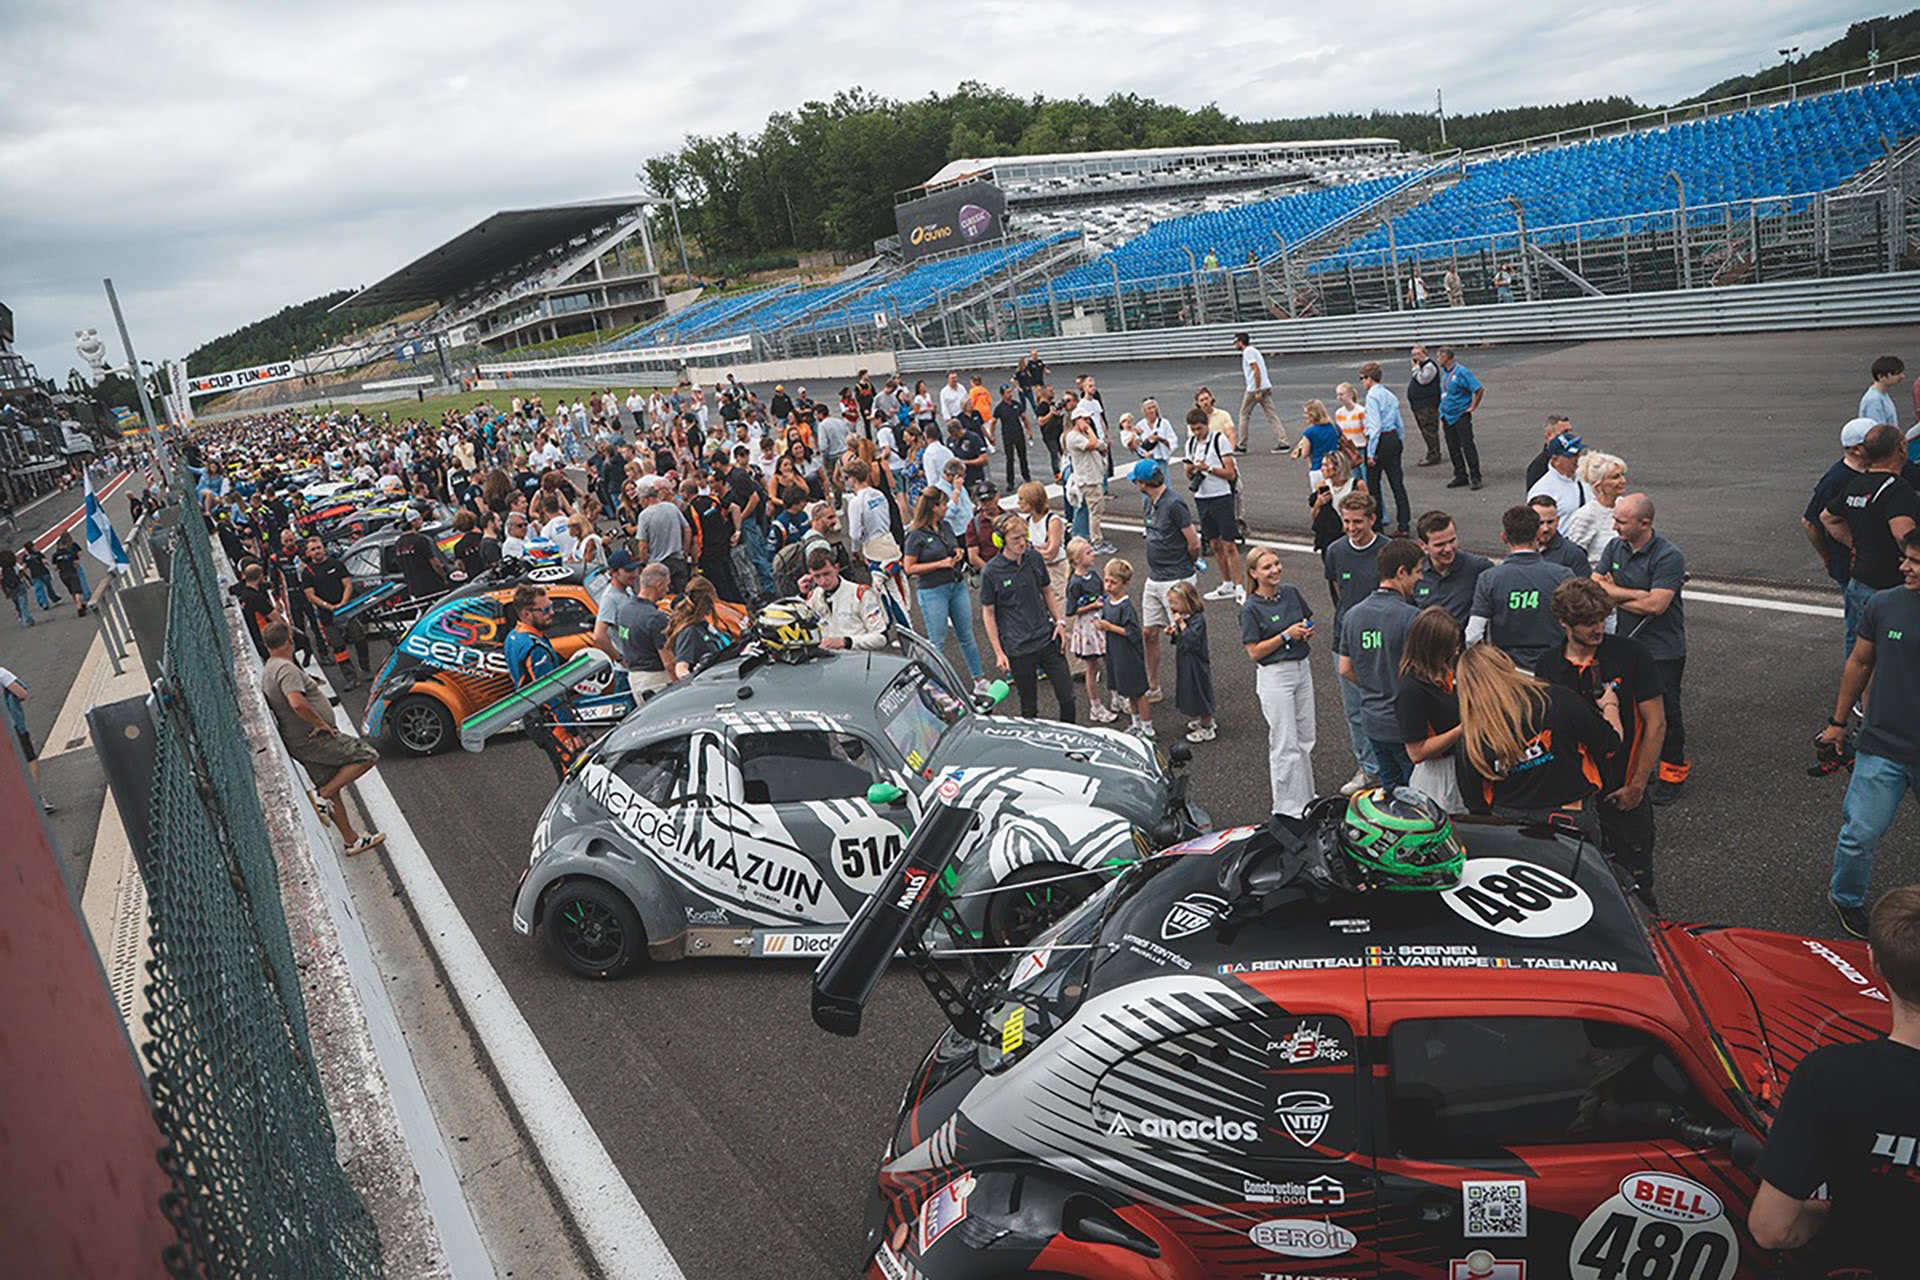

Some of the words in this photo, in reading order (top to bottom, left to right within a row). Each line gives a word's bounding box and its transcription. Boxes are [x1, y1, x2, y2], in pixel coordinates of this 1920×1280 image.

[209, 375, 233, 389] CUP
[236, 369, 260, 385] FUN
[267, 363, 291, 378] CUP
[1509, 591, 1540, 609] 514
[1362, 631, 1382, 650] 514
[683, 830, 824, 906] MAZUIN
[1452, 864, 1578, 927] 480
[1173, 908, 1209, 928] VTB
[1382, 947, 1396, 956] J.
[1398, 945, 1477, 956] SOENEN
[1233, 962, 1249, 973] A.
[1252, 957, 1363, 971] RENNETEAU
[1382, 956, 1396, 966] T.
[1399, 956, 1440, 967] VAN
[1442, 956, 1489, 967] IMPE
[1506, 957, 1521, 968] L.
[1523, 957, 1618, 972] TAELMAN
[1140, 1115, 1258, 1142] anaclos
[1286, 1114, 1324, 1129] VTB
[1244, 1180, 1307, 1197] Construction
[1634, 1179, 1708, 1216] BELL
[1274, 1195, 1307, 1205] 2000
[1577, 1211, 1730, 1280] 480
